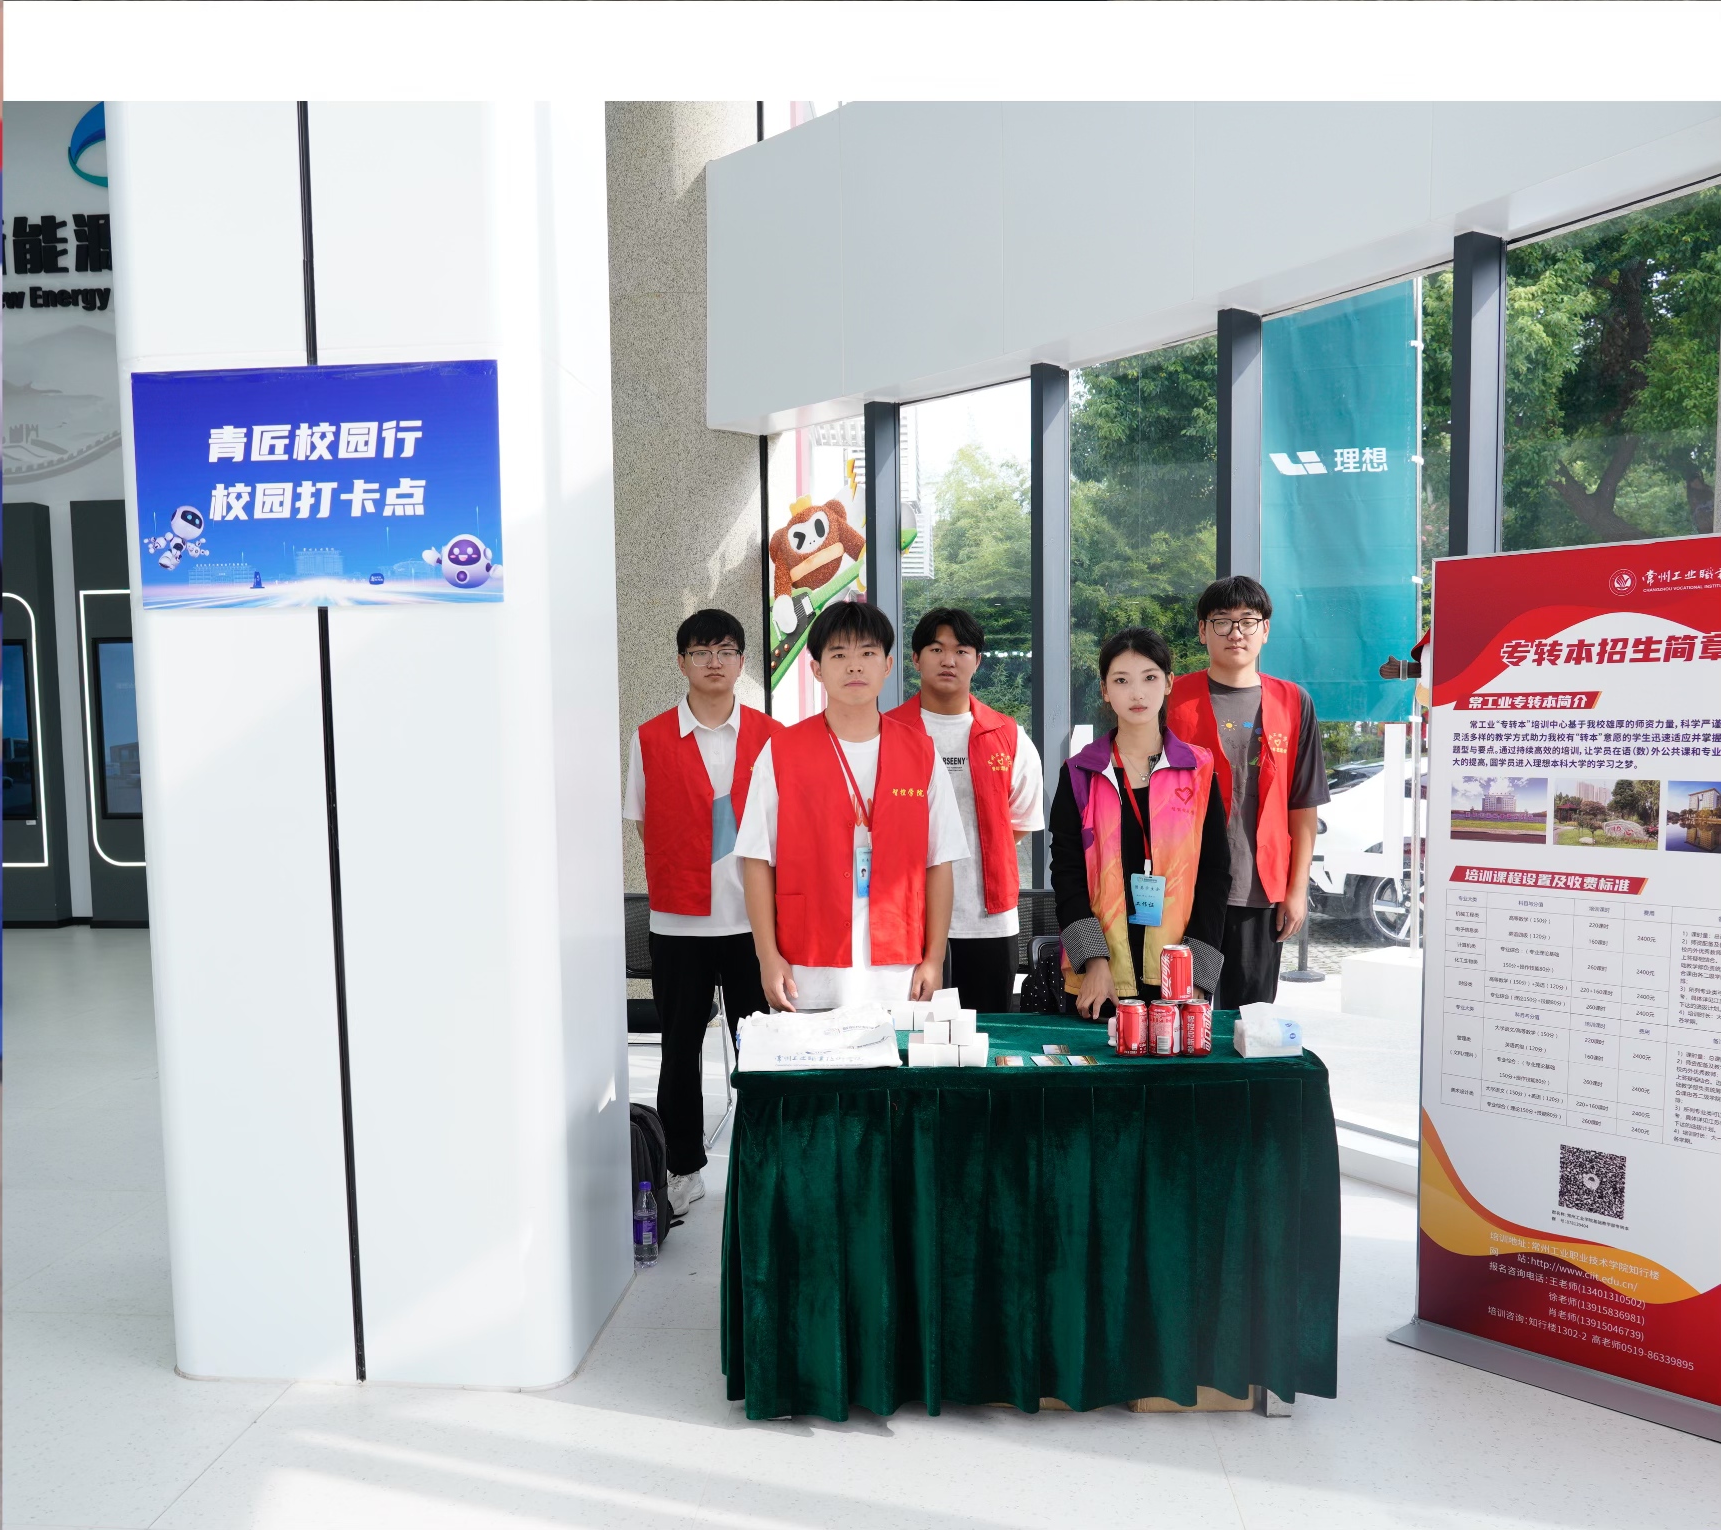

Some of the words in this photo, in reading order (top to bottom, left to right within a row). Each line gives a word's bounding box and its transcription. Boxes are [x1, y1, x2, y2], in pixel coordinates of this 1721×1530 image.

[2, 214, 113, 275] 能源
[30, 286, 111, 311] Energy
[208, 420, 423, 463] 青匠校园行
[1334, 447, 1389, 474] 理想
[209, 478, 426, 521] 校园打卡点
[1500, 632, 1721, 667] 专转本招生简章
[1467, 694, 1588, 709] 常工业专转本简介
[1464, 869, 1631, 892] 培训课程设置及收费标准
[1488, 1247, 1499, 1257] 网
